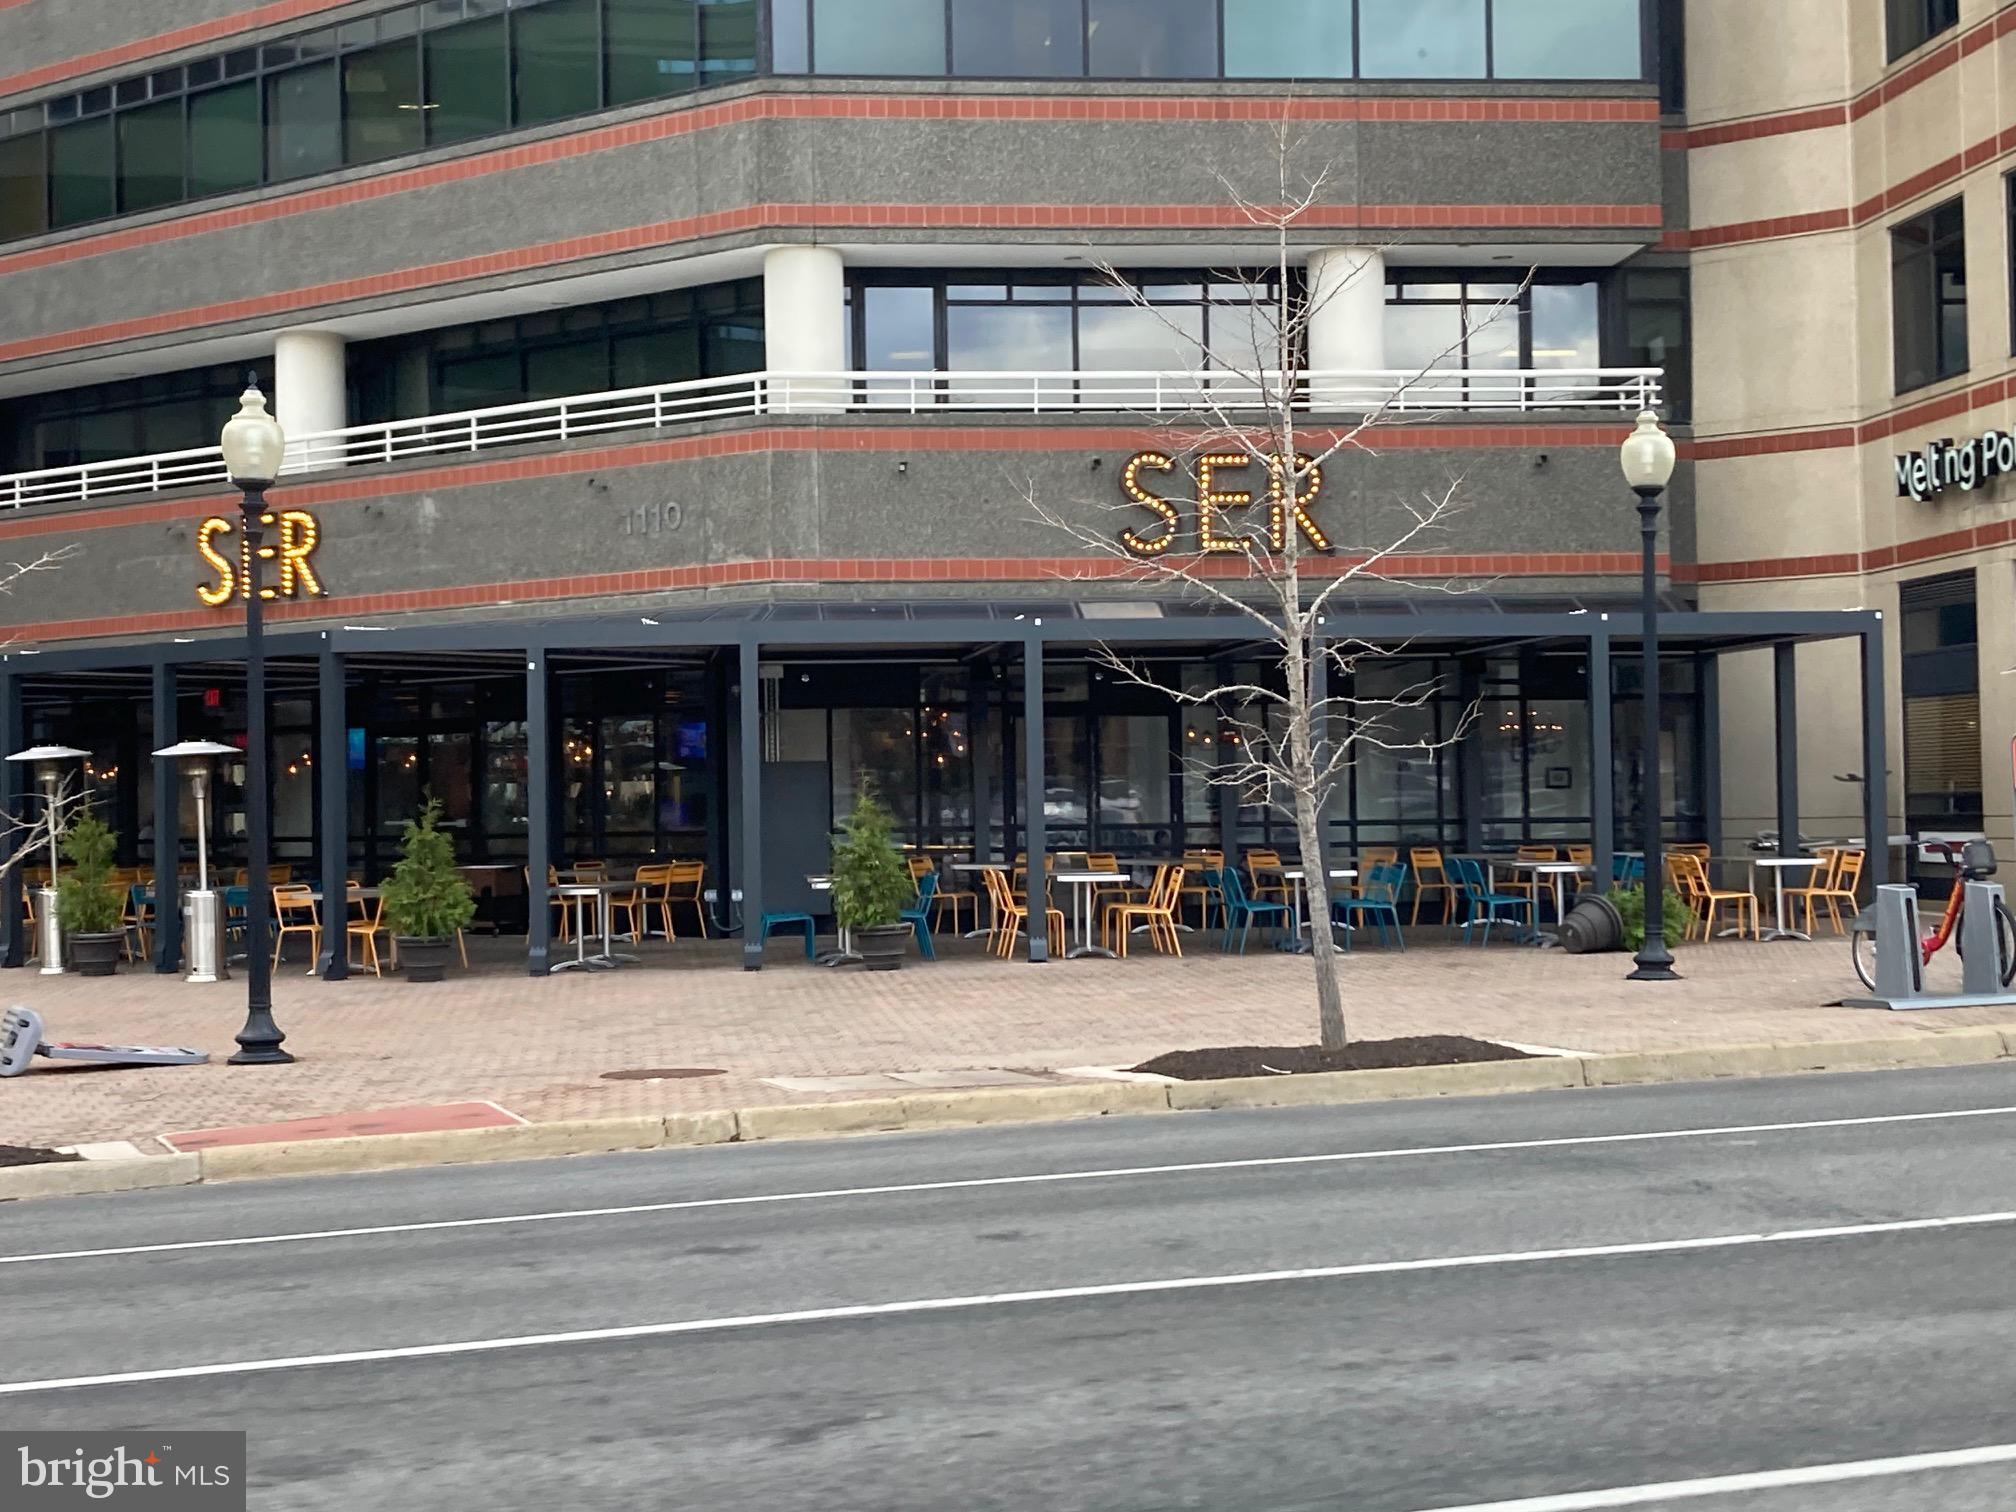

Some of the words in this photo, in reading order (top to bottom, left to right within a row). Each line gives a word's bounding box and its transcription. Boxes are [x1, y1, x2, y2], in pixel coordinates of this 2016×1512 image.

[620, 502, 683, 536] 1110
[1119, 451, 1334, 558] SER
[196, 509, 326, 607] SER
